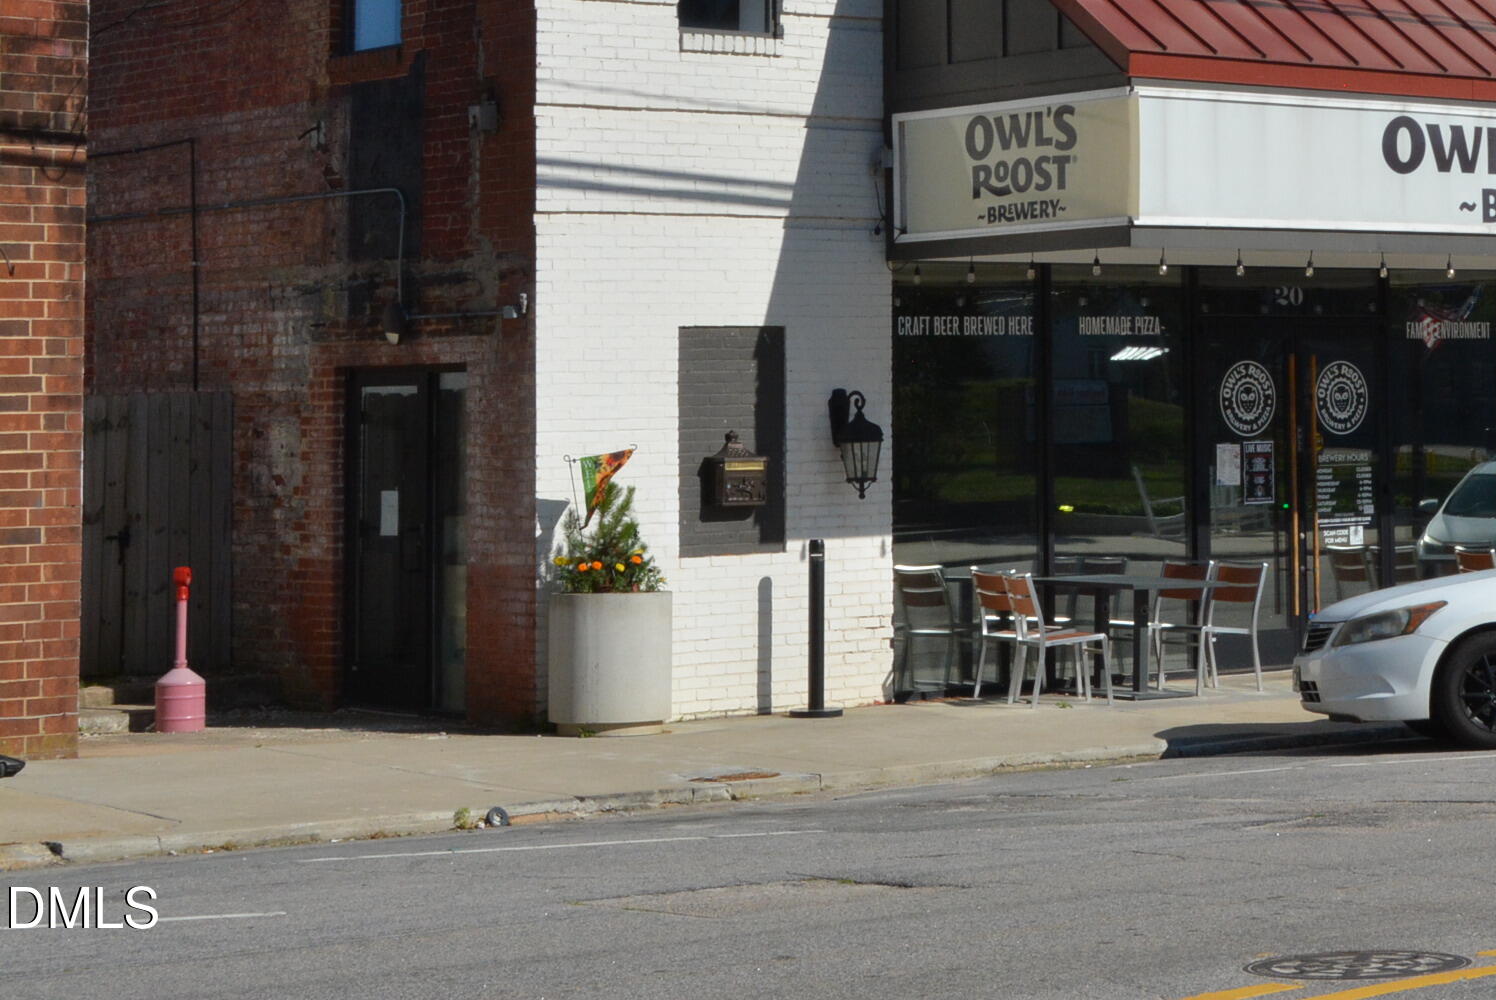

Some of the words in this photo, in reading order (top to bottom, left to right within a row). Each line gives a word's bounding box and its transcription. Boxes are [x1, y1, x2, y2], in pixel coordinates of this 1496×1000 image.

[965, 104, 1078, 161] OWL'S
[1274, 287, 1303, 305] 20
[898, 316, 931, 336] CRAFT
[933, 316, 960, 336] BEER
[963, 316, 1006, 336] BREWED
[1008, 316, 1034, 336] HERE
[1079, 316, 1132, 336] HOMEMADE
[1135, 316, 1161, 336] PIZZA
[1223, 365, 1246, 398] OWL'S
[1317, 365, 1339, 398] OWL'S
[1226, 408, 1250, 431] BREWERY
[1257, 406, 1271, 429] PIZZA
[1321, 408, 1346, 430] BREWERY
[1352, 405, 1364, 427] PIZZA
[1318, 454, 1345, 462] BREWERY
[1347, 453, 1368, 461] HOURS
[1323, 529, 1336, 537] SCAN
